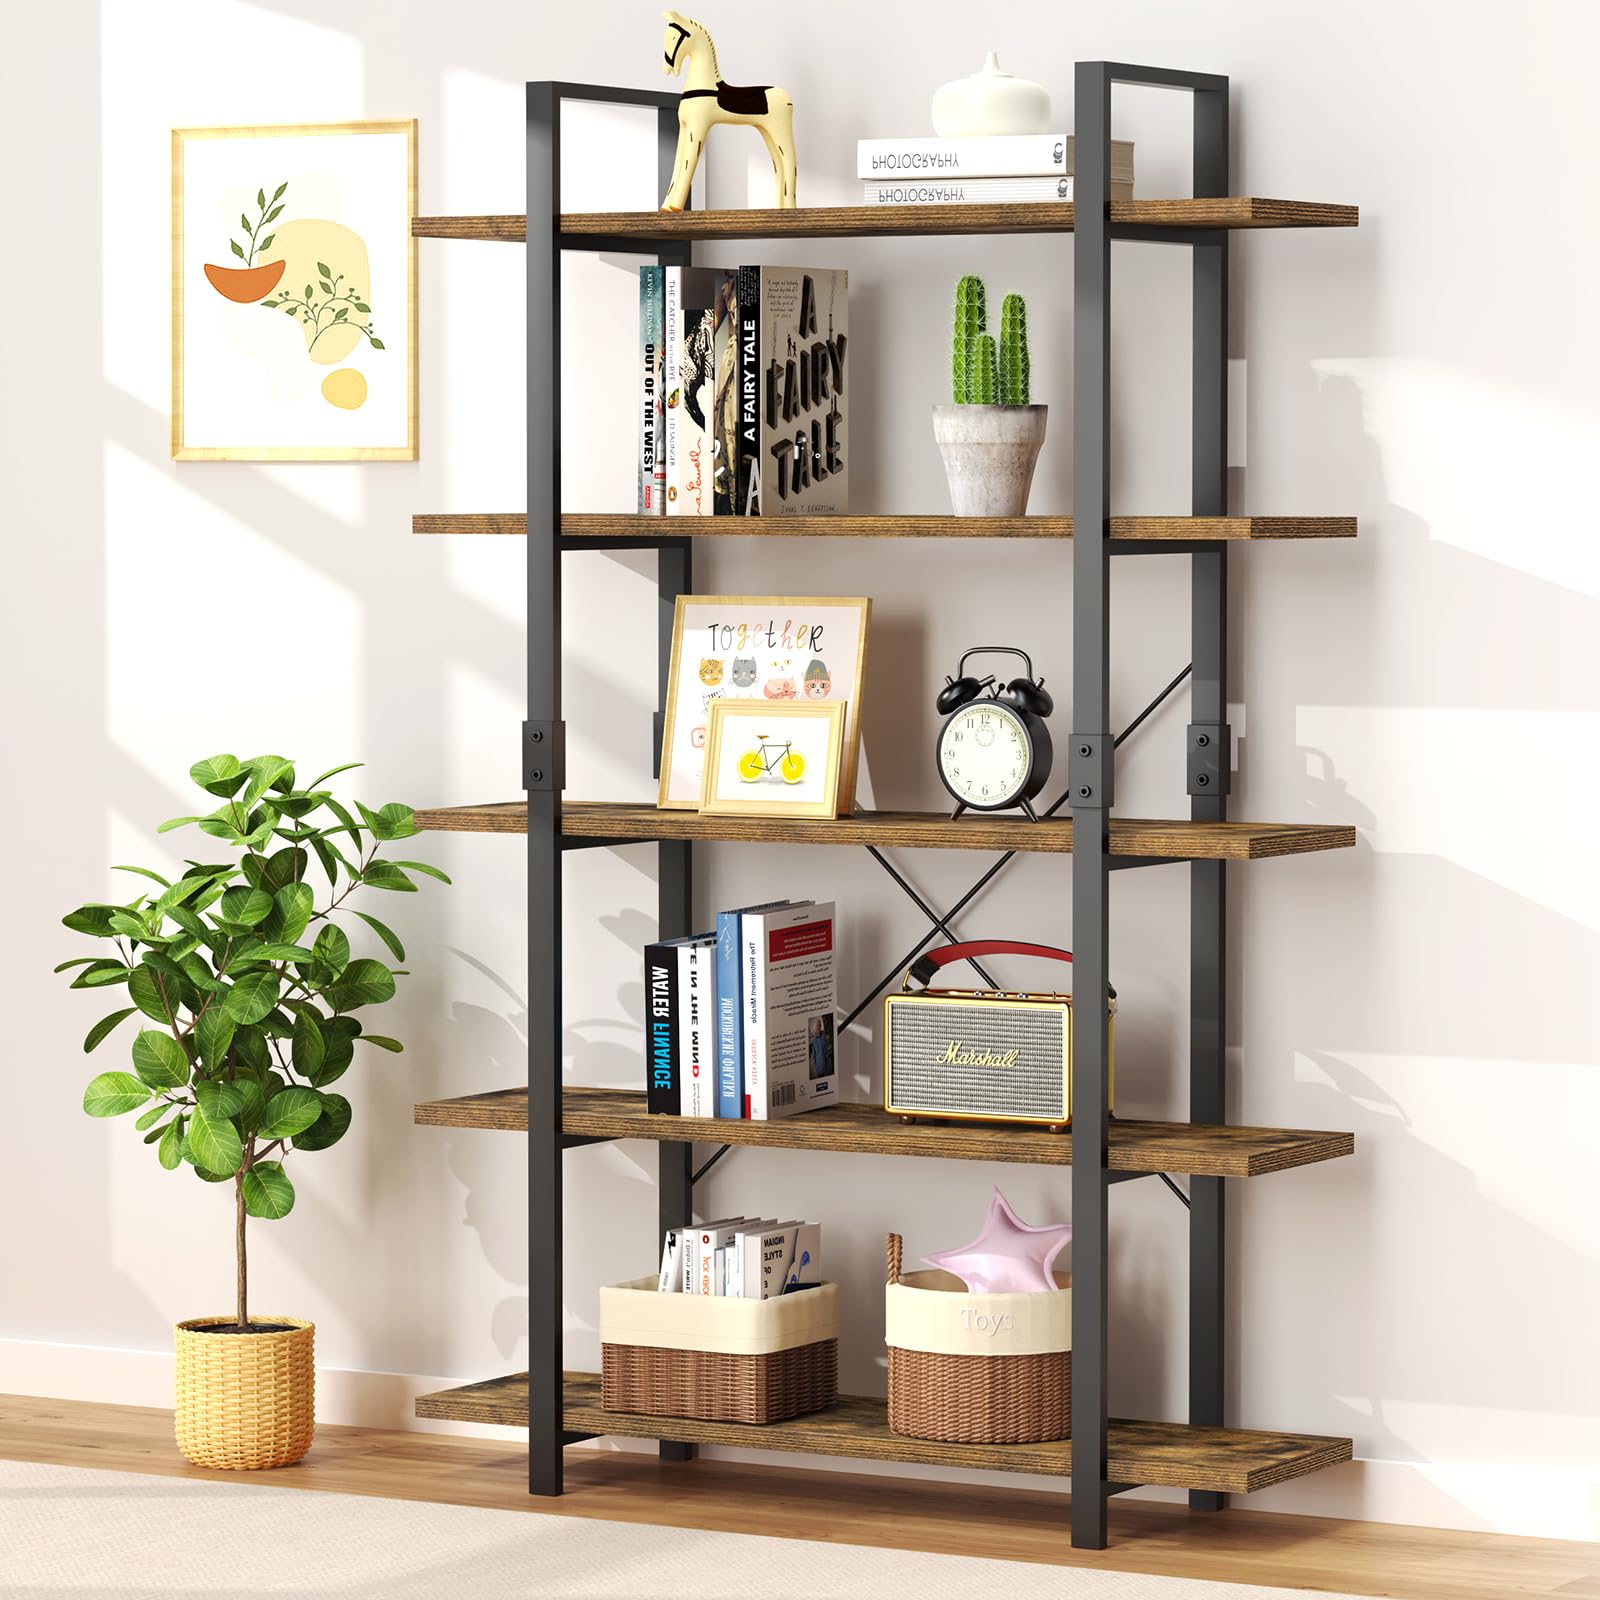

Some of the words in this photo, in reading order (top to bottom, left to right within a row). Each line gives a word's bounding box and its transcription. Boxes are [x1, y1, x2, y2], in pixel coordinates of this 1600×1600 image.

[744, 319, 756, 369] TALE
[644, 343, 655, 374] OUT
[644, 376, 655, 396] OF
[766, 333, 847, 430] FAIRY
[744, 375, 756, 421] FAIRY
[644, 400, 655, 428] THE
[744, 427, 756, 442] A
[644, 430, 655, 474] WEST
[966, 719, 974, 729] 11
[981, 714, 990, 724] 12
[954, 732, 964, 742] 10
[1011, 732, 1017, 742] 2
[948, 750, 956, 760] 9
[1016, 750, 1022, 760] 3
[953, 768, 960, 777] 8
[1010, 768, 1016, 778] 4
[966, 780, 972, 791] 7
[982, 785, 988, 796] 6
[1000, 781, 1006, 791] 5
[936, 1040, 1020, 1068] Marshall
[960, 1306, 1015, 1337] Toys
